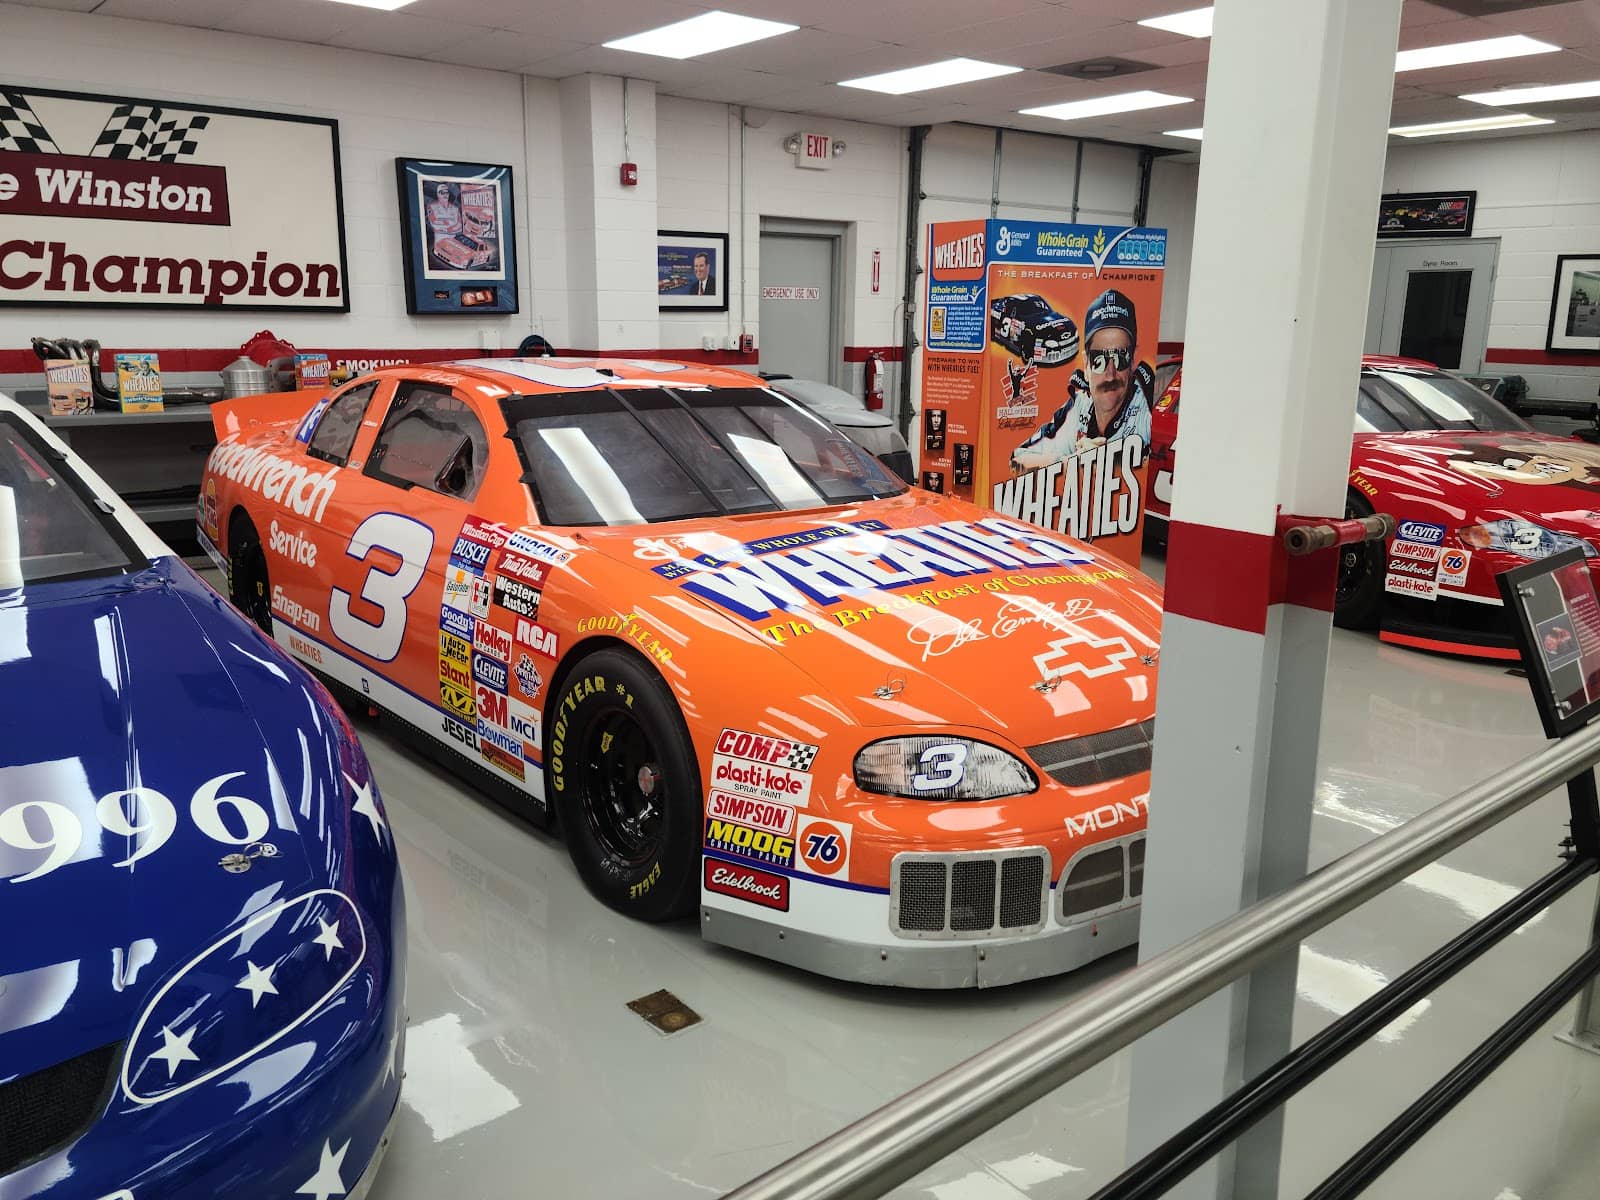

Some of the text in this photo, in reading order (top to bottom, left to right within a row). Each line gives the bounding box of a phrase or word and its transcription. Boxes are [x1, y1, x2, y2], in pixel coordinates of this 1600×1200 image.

[808, 135, 828, 158] EXIT
[35, 168, 213, 213] Winston
[935, 232, 985, 269] WHEATIES
[1037, 248, 1083, 260] Guaranteed
[1038, 232, 1089, 252] Whole Grain
[0, 240, 340, 304] Champion
[998, 270, 1155, 282] THE BREAKFAST OF CHAMPIONS
[763, 287, 818, 298] EMERGENCY USE ONLY
[931, 293, 969, 302] Guaranteed
[50, 368, 89, 384] WHEATIES
[123, 377, 161, 392] WHEATIES
[301, 363, 329, 378] WHEATIES
[993, 433, 1142, 544] WHEATIES
[269, 519, 318, 568] Service
[462, 523, 506, 549] Winston Cup
[752, 519, 882, 552] WHOLE WHAT
[1400, 522, 1442, 541] CLEVITE
[1510, 527, 1543, 551] 3
[453, 538, 489, 563] BUSCH
[1394, 543, 1437, 560] SIMPSON
[1445, 556, 1463, 569] 76
[678, 517, 1096, 622] WHEATIES
[1389, 560, 1435, 577] Edelbrock
[329, 512, 434, 663] 3
[496, 574, 541, 605] Western
[272, 585, 320, 631] Snap-on
[441, 606, 475, 631] Goody's
[760, 620, 822, 644] The
[831, 581, 980, 629] Breakfast
[982, 576, 1008, 594] of
[289, 634, 322, 664] WHEATIES
[448, 637, 466, 653] Auto
[475, 621, 511, 662] Holley
[516, 619, 558, 658] RCA
[577, 613, 673, 664] GOODYEAR
[446, 646, 470, 665] Meter
[475, 654, 506, 685] CLEVITE
[440, 660, 471, 690] Stant
[477, 686, 508, 730] 3M
[441, 717, 482, 756] JESEL
[477, 718, 524, 764] Bowman
[510, 715, 536, 742] MCI
[552, 675, 606, 792] GOODYEAR
[716, 730, 791, 764] COMP
[914, 743, 968, 792] 3
[734, 782, 783, 801] SPRAY PAINT
[0, 770, 270, 883] 996
[714, 794, 788, 829] SIMPSON
[1064, 793, 1149, 838] MONT
[708, 822, 796, 859] MOOG
[807, 834, 843, 864] 76
[758, 852, 791, 870] PARTS
[630, 861, 661, 898] EAGLE
[711, 870, 781, 900] Edelbrock
